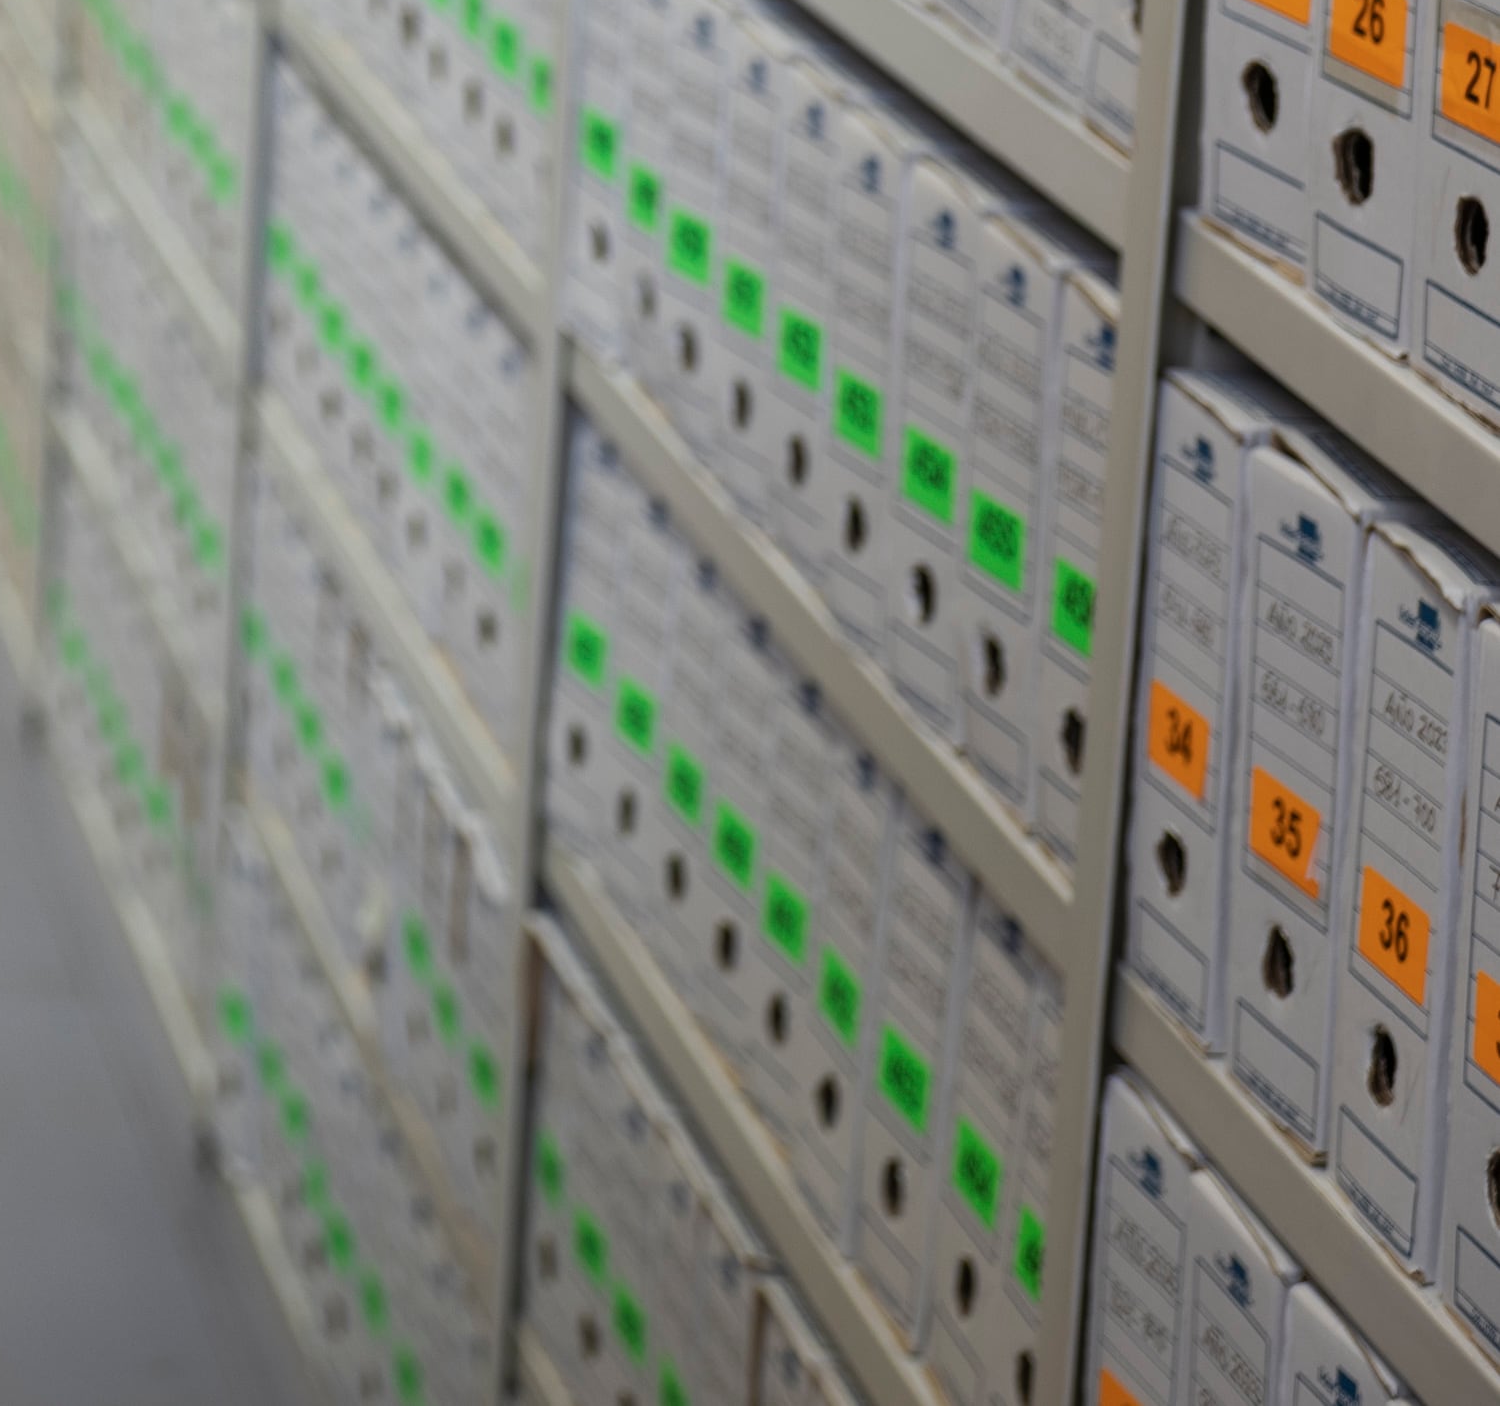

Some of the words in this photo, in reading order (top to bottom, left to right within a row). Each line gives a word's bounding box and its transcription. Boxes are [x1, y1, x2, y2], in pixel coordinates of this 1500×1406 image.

[1464, 50, 1496, 110] 27
[1269, 796, 1304, 860] 35
[1379, 897, 1411, 964] 36
